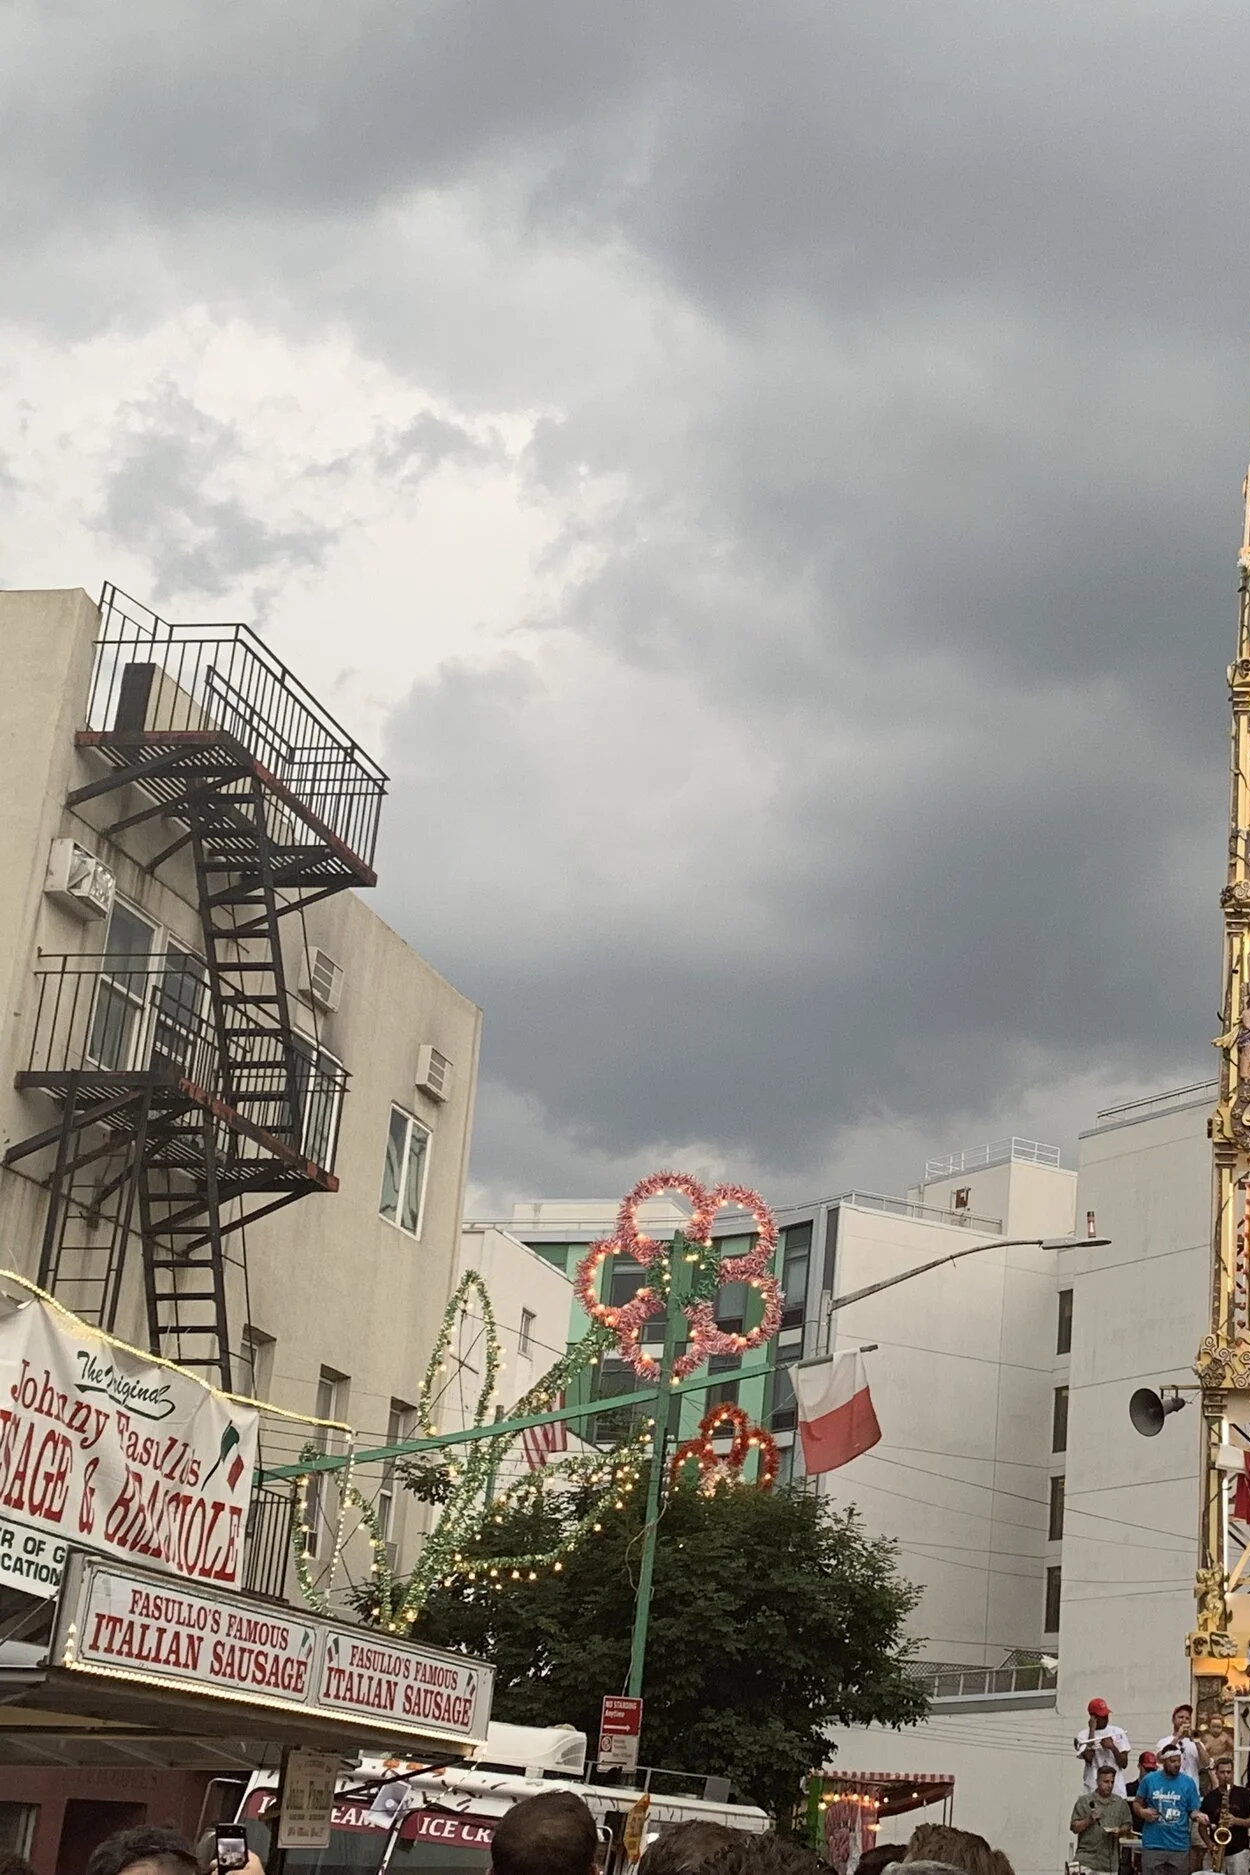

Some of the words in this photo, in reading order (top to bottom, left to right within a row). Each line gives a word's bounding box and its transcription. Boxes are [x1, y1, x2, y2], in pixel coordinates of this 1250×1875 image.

[77, 1350, 103, 1384] The
[11, 1359, 110, 1450] Johnny
[79, 1457, 100, 1535] &
[23, 1536, 47, 1557] OF
[129, 1588, 222, 1635] FASULLO'S
[226, 1613, 290, 1651] FAMOUS
[88, 1612, 204, 1671] ITALIAN
[209, 1639, 308, 1694] SAUSAGE
[349, 1644, 412, 1680] FASULLO'S
[414, 1661, 459, 1691] FAMOUS
[323, 1666, 399, 1711] ITALIAN
[402, 1684, 473, 1727] SAUSAGE
[418, 1817, 459, 1838] ICE
